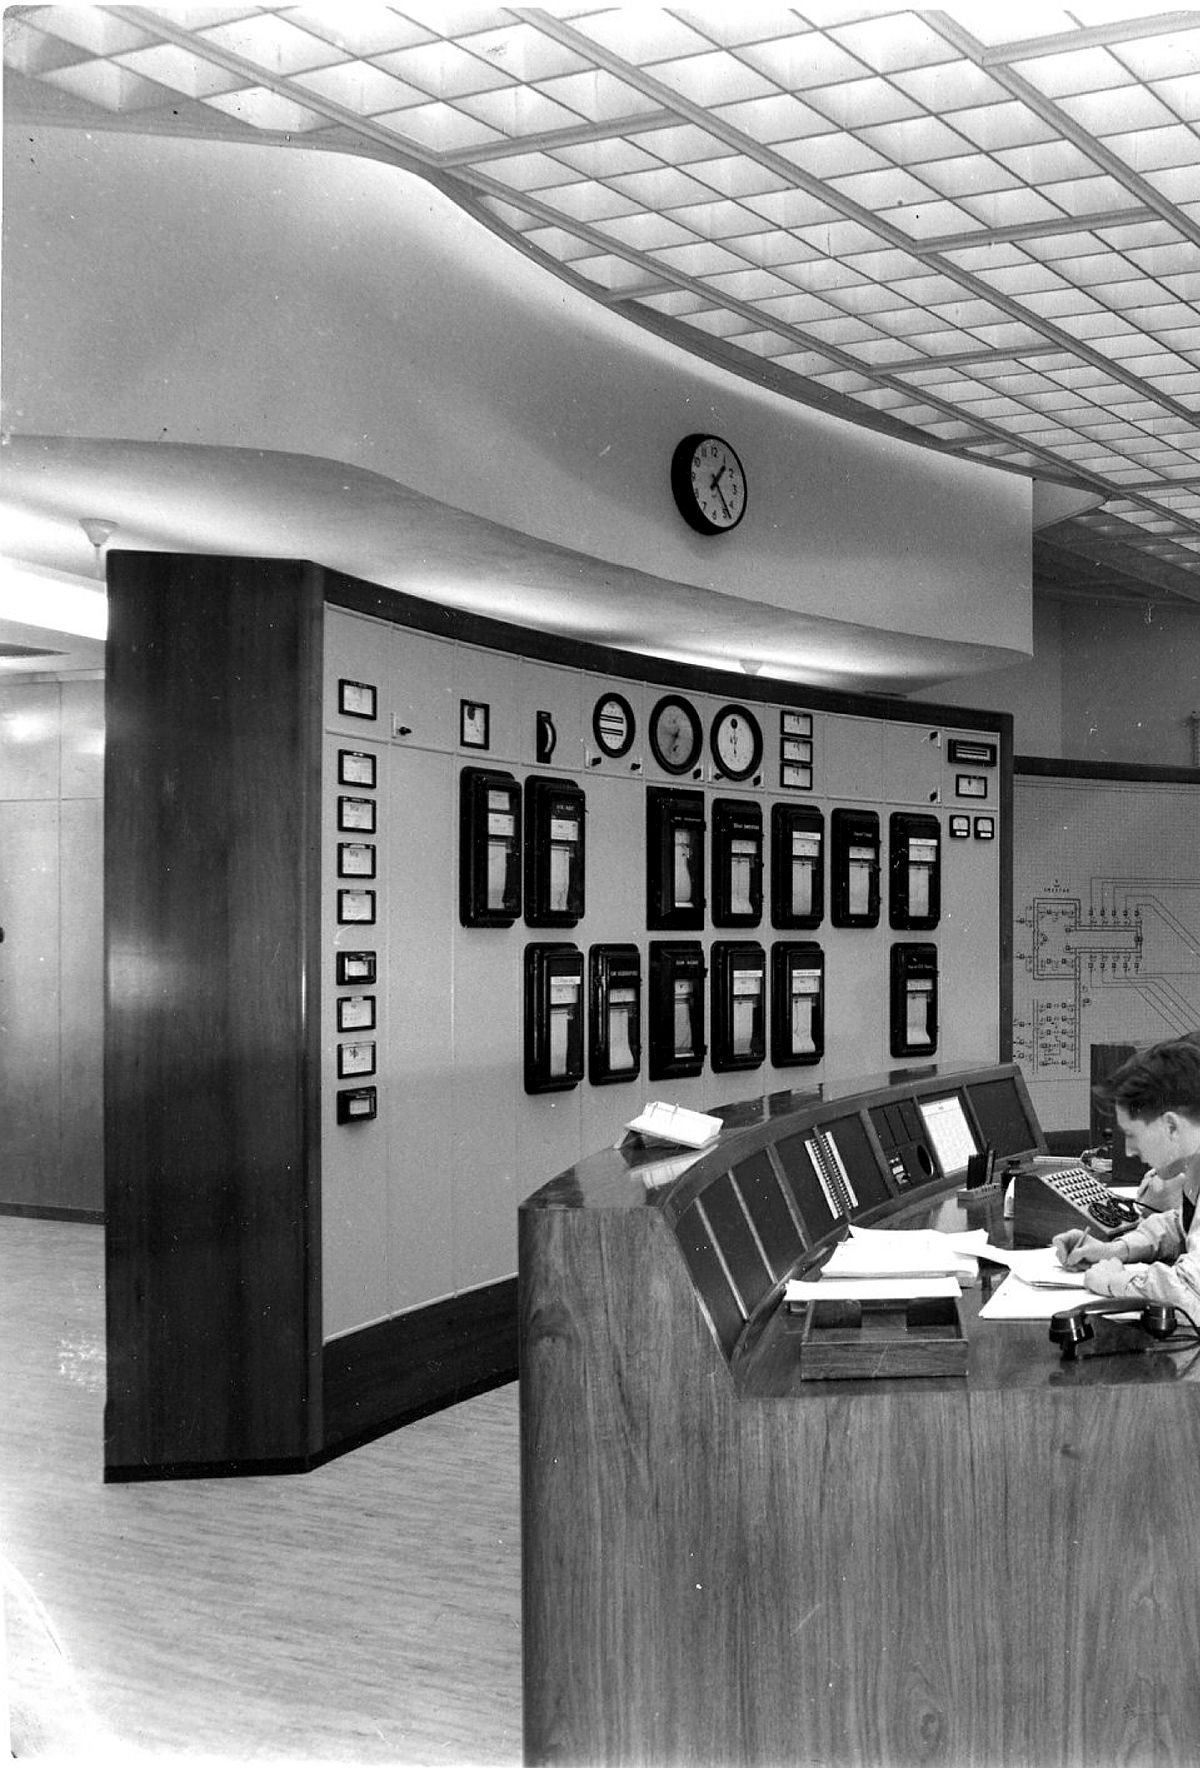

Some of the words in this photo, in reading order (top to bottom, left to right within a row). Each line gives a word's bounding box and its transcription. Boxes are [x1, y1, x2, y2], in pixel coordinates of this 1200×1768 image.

[711, 446, 719, 458] 12
[728, 467, 735, 479] 2
[732, 482, 738, 496] 3
